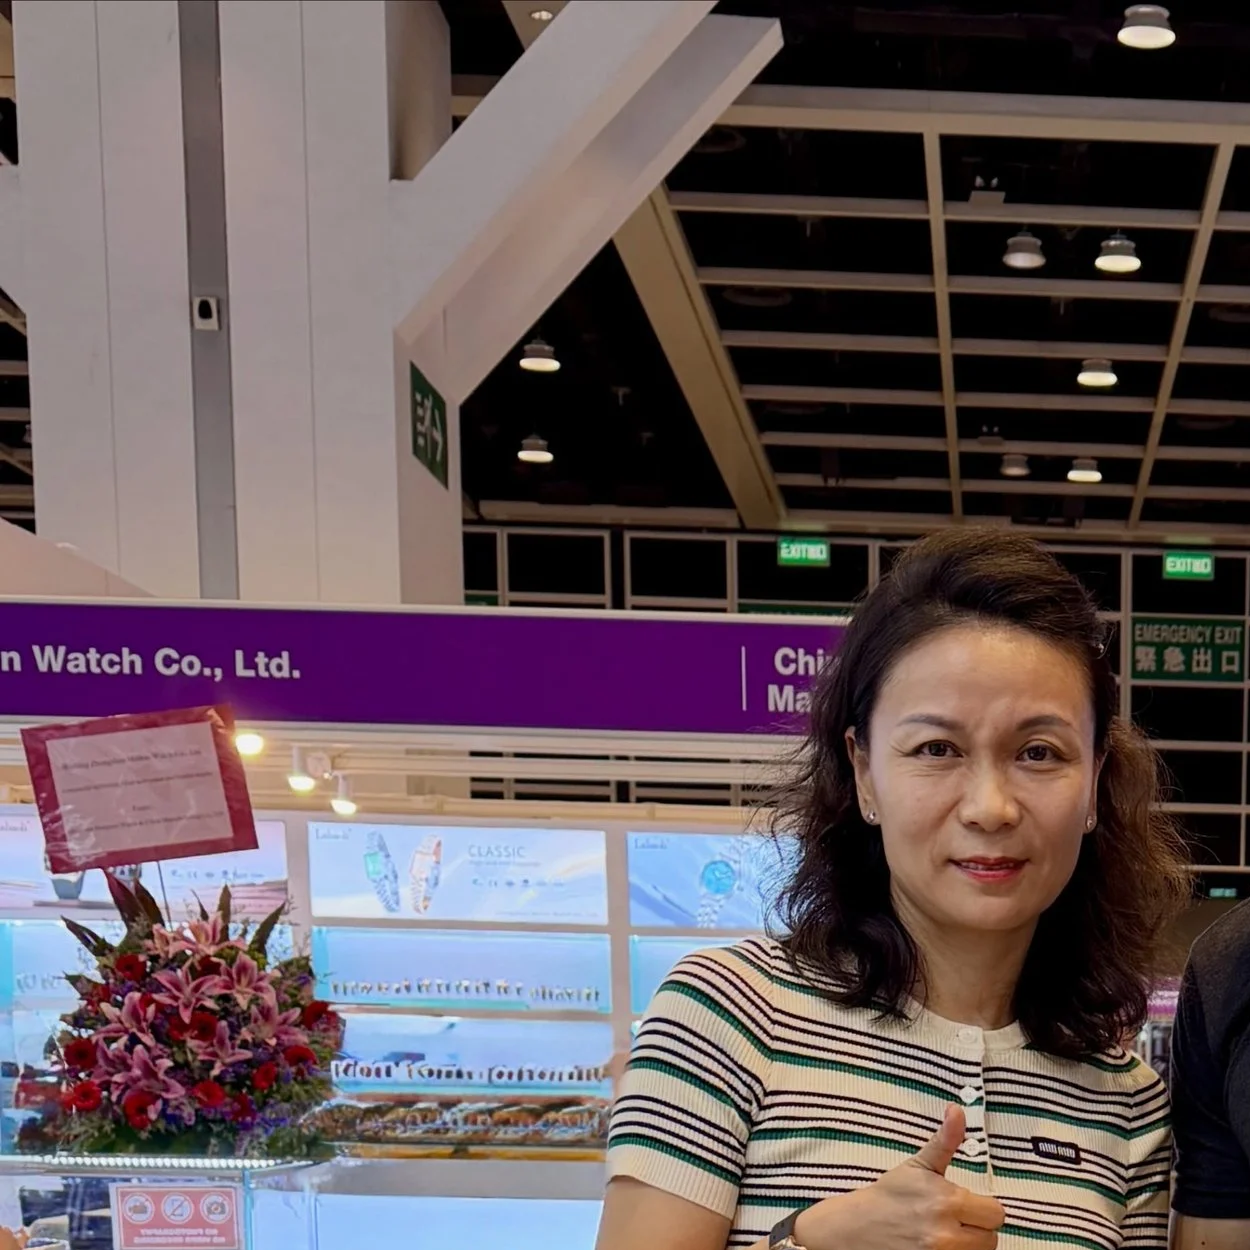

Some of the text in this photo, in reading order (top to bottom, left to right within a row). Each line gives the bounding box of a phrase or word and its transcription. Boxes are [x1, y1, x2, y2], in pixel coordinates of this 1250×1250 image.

[1135, 624, 1242, 644] EMERGENCY EXIT
[32, 645, 143, 675] Watch
[154, 648, 222, 682] Co.,
[235, 650, 301, 679] Ltd.
[468, 844, 526, 858] CLASSIC
